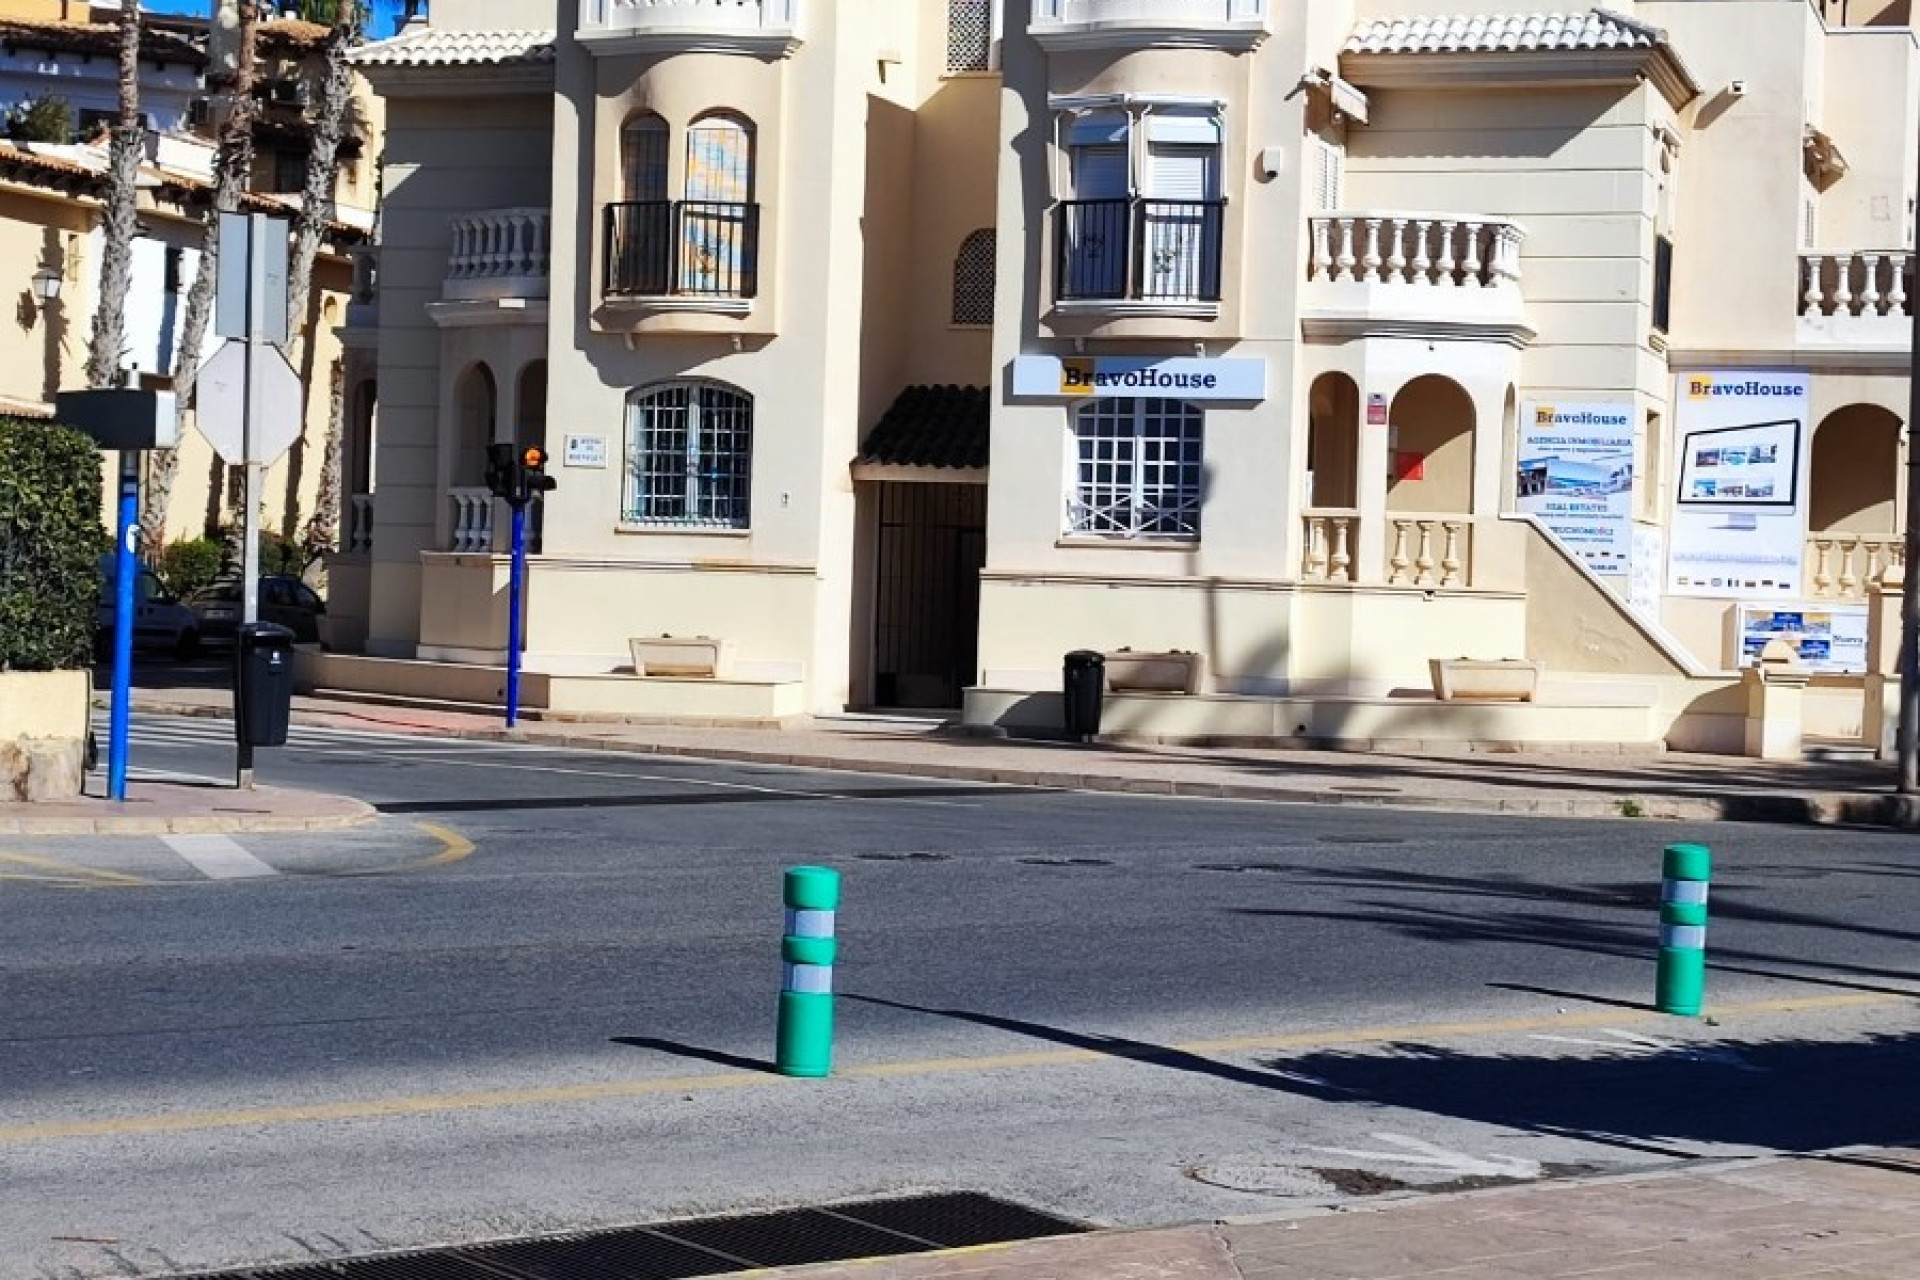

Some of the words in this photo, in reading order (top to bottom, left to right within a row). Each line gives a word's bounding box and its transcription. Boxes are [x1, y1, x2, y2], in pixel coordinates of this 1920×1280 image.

[1063, 367, 1217, 388] BravoHouse
[1690, 381, 1804, 396] BravoHouse
[1536, 411, 1627, 425] BravoHouse
